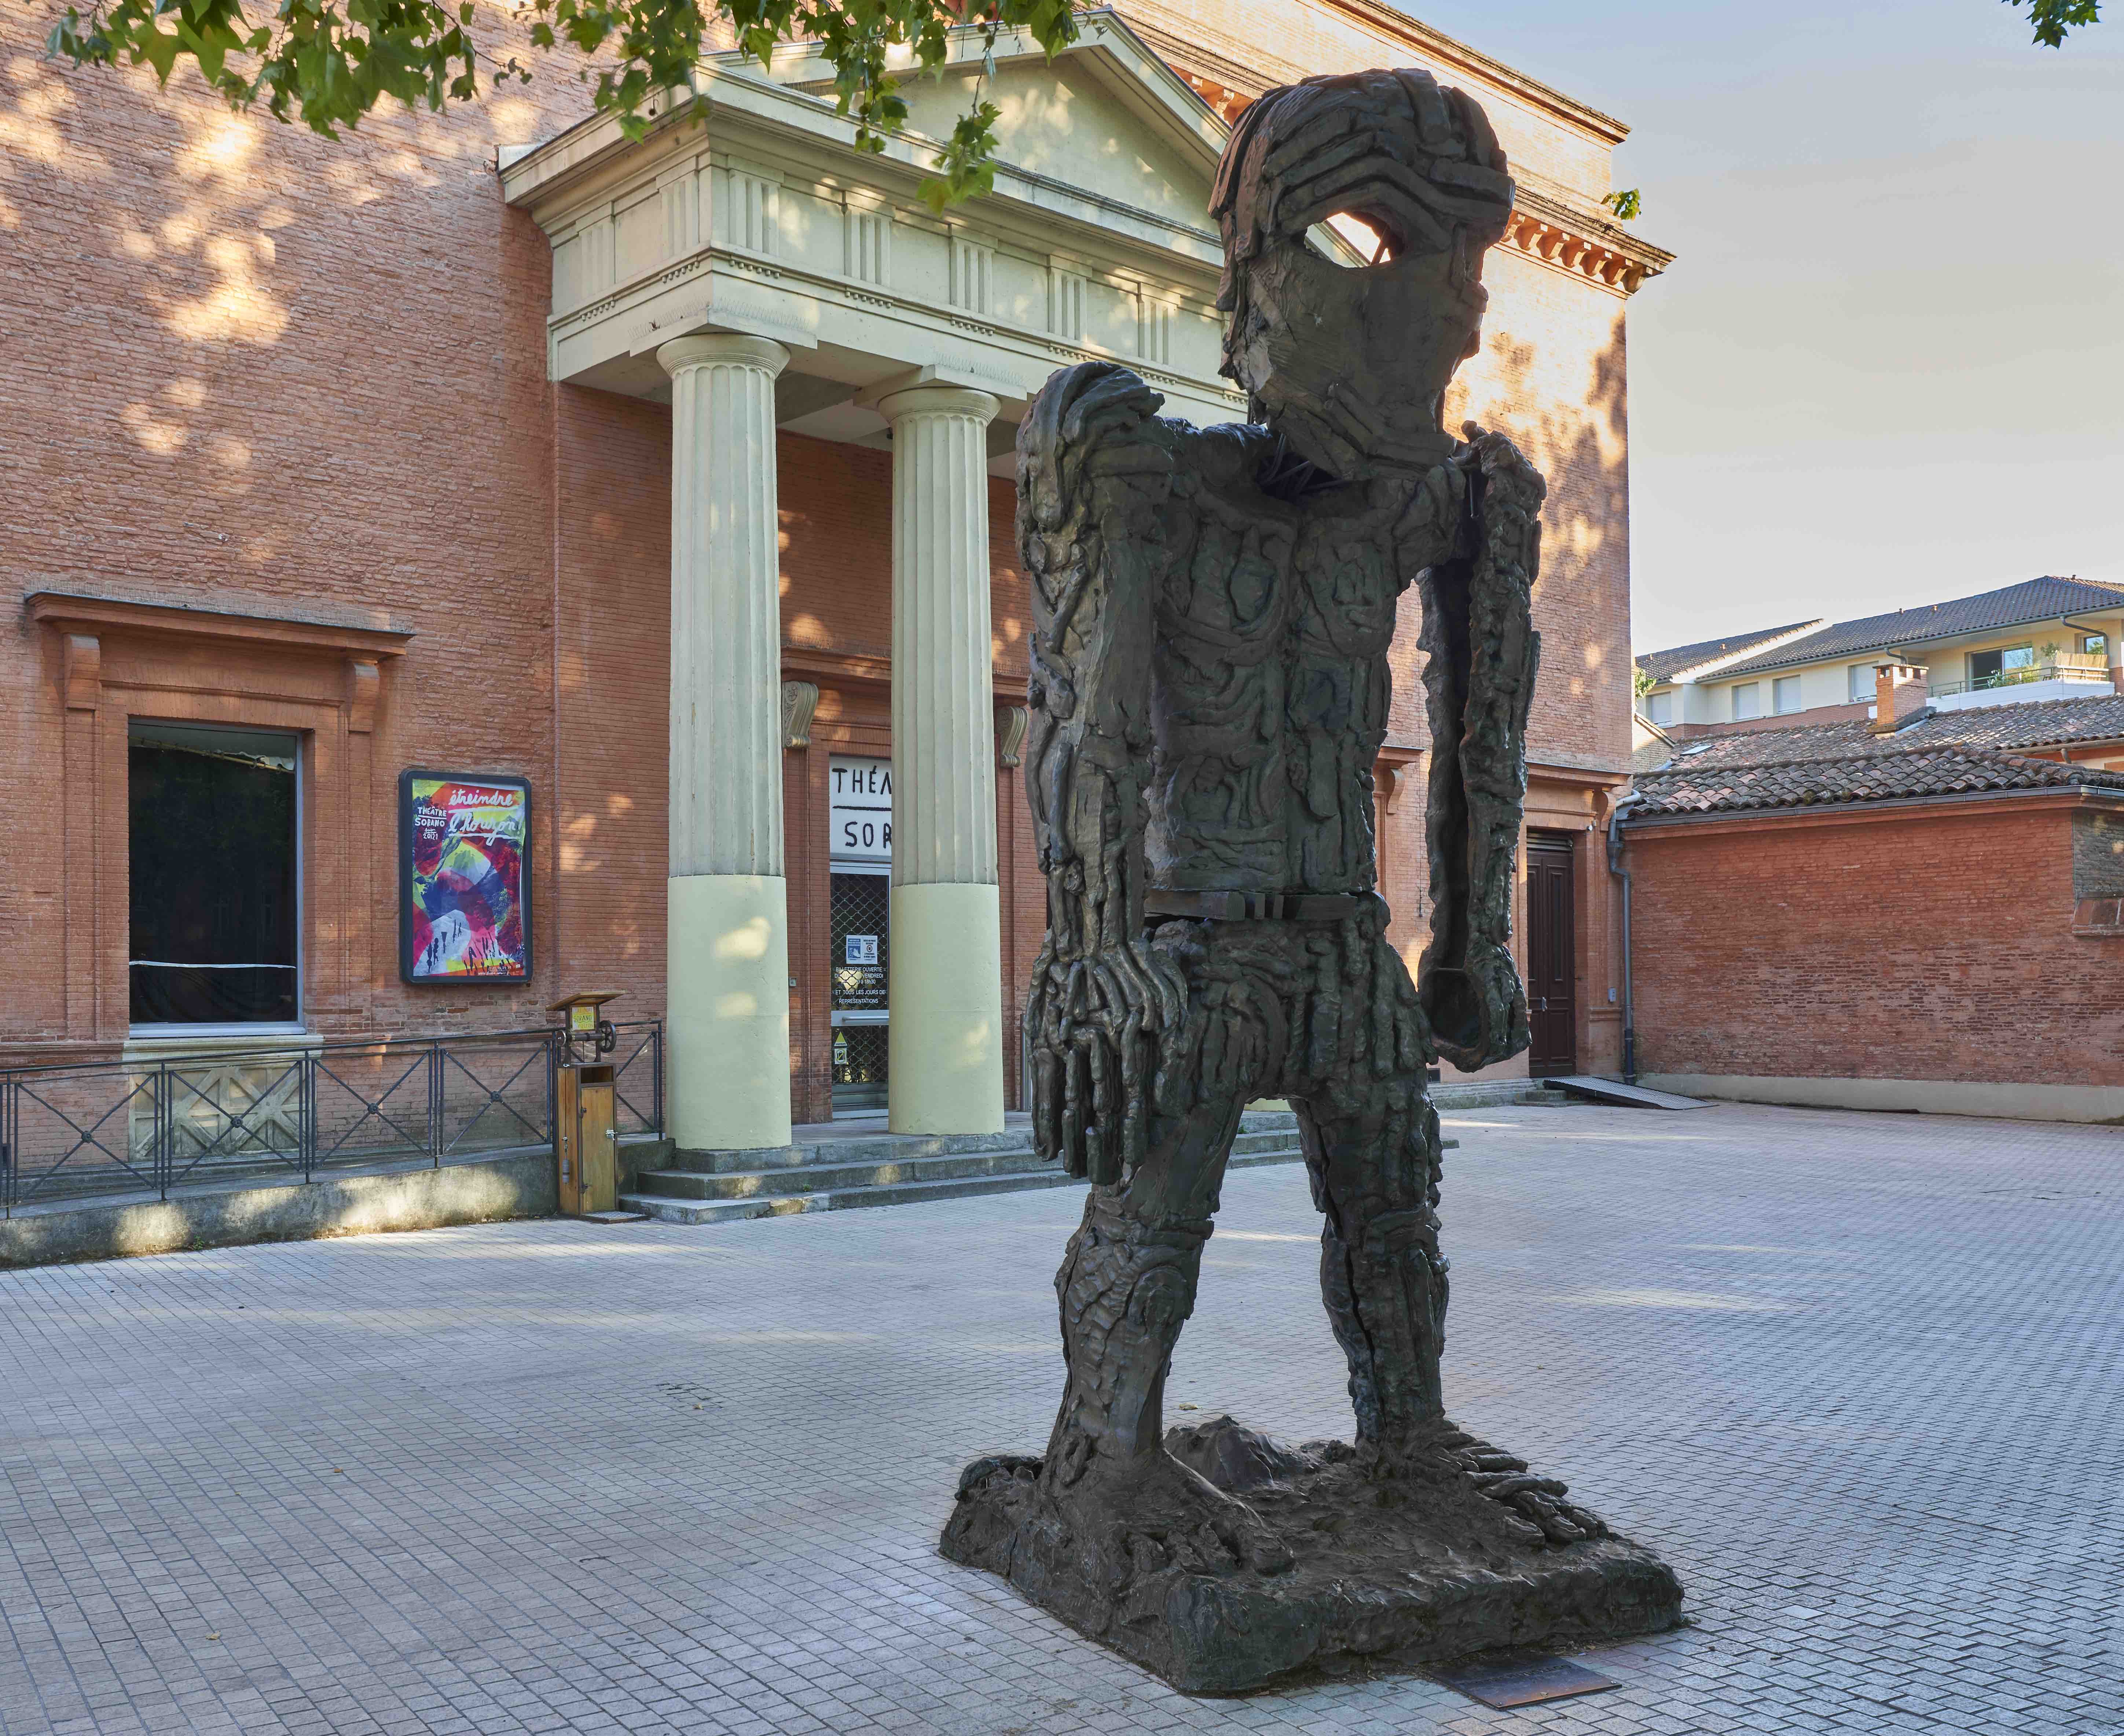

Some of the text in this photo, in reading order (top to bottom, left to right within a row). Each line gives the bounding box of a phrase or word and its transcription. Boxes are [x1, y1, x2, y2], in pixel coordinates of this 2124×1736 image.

[448, 789, 513, 806] étreindre
[415, 817, 445, 827] SORANO
[844, 821, 892, 849] SOR
